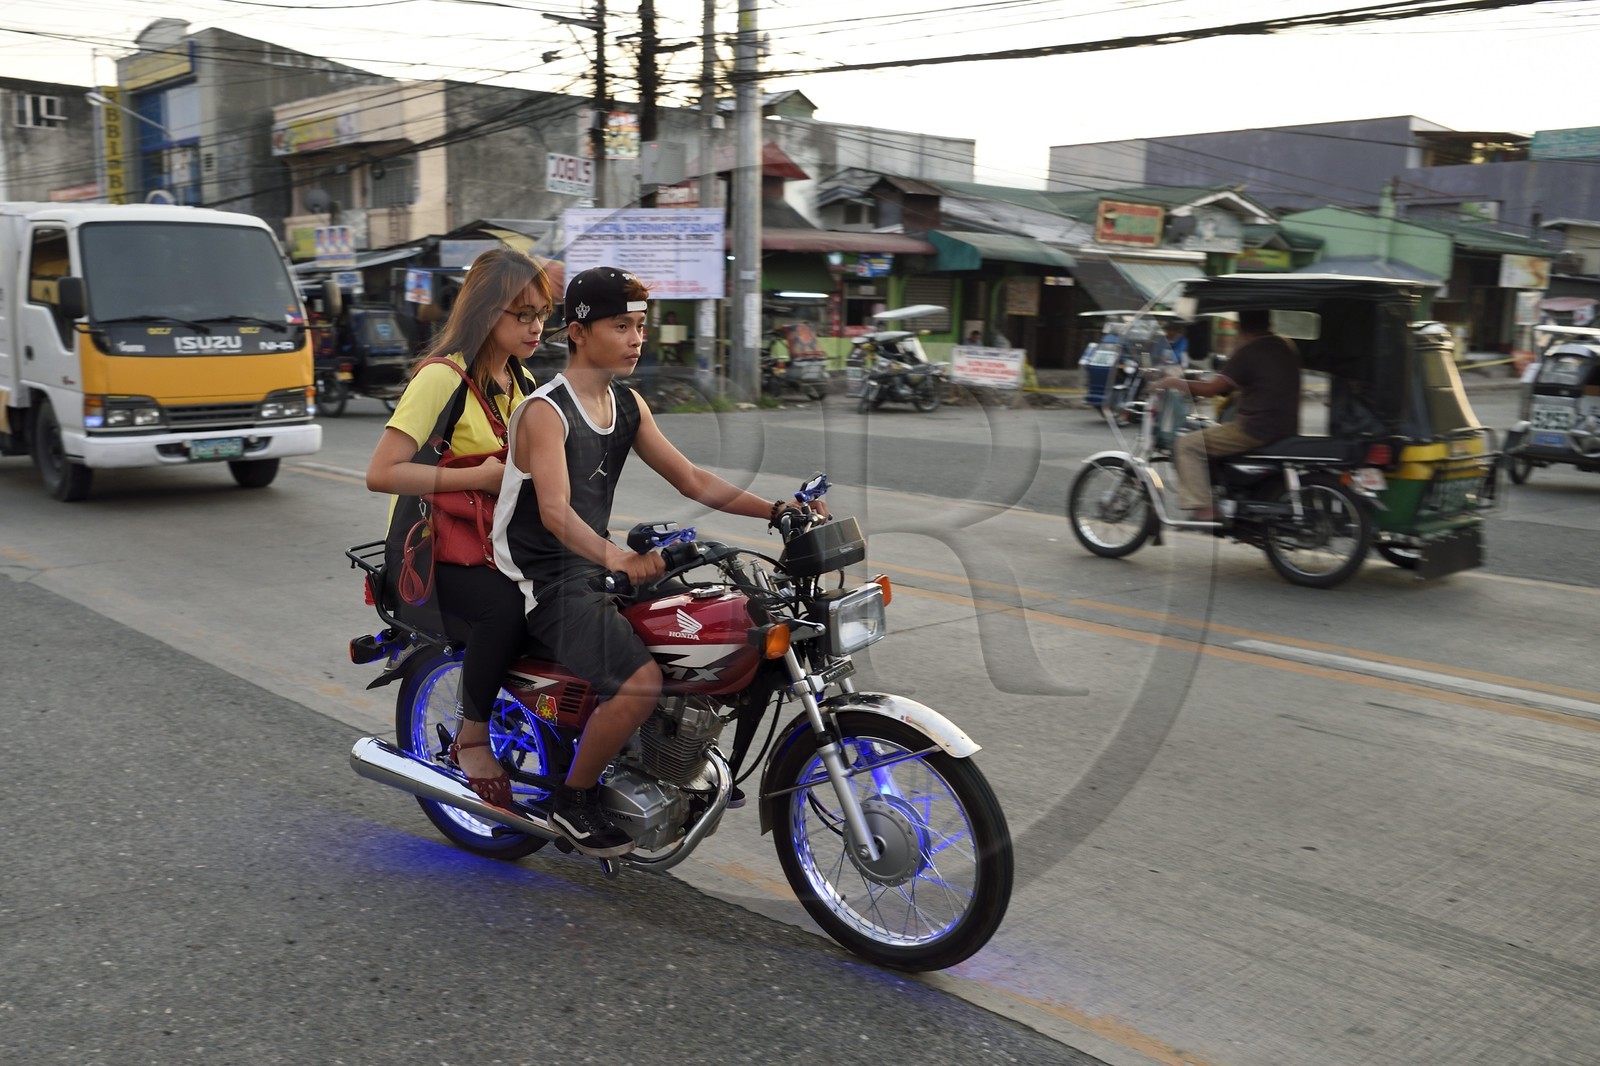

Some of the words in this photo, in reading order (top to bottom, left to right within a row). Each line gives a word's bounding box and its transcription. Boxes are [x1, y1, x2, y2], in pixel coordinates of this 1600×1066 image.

[174, 336, 242, 350] ISUZU
[259, 341, 295, 350] NHR
[669, 631, 700, 640] HONDA
[825, 664, 852, 681] HONDA
